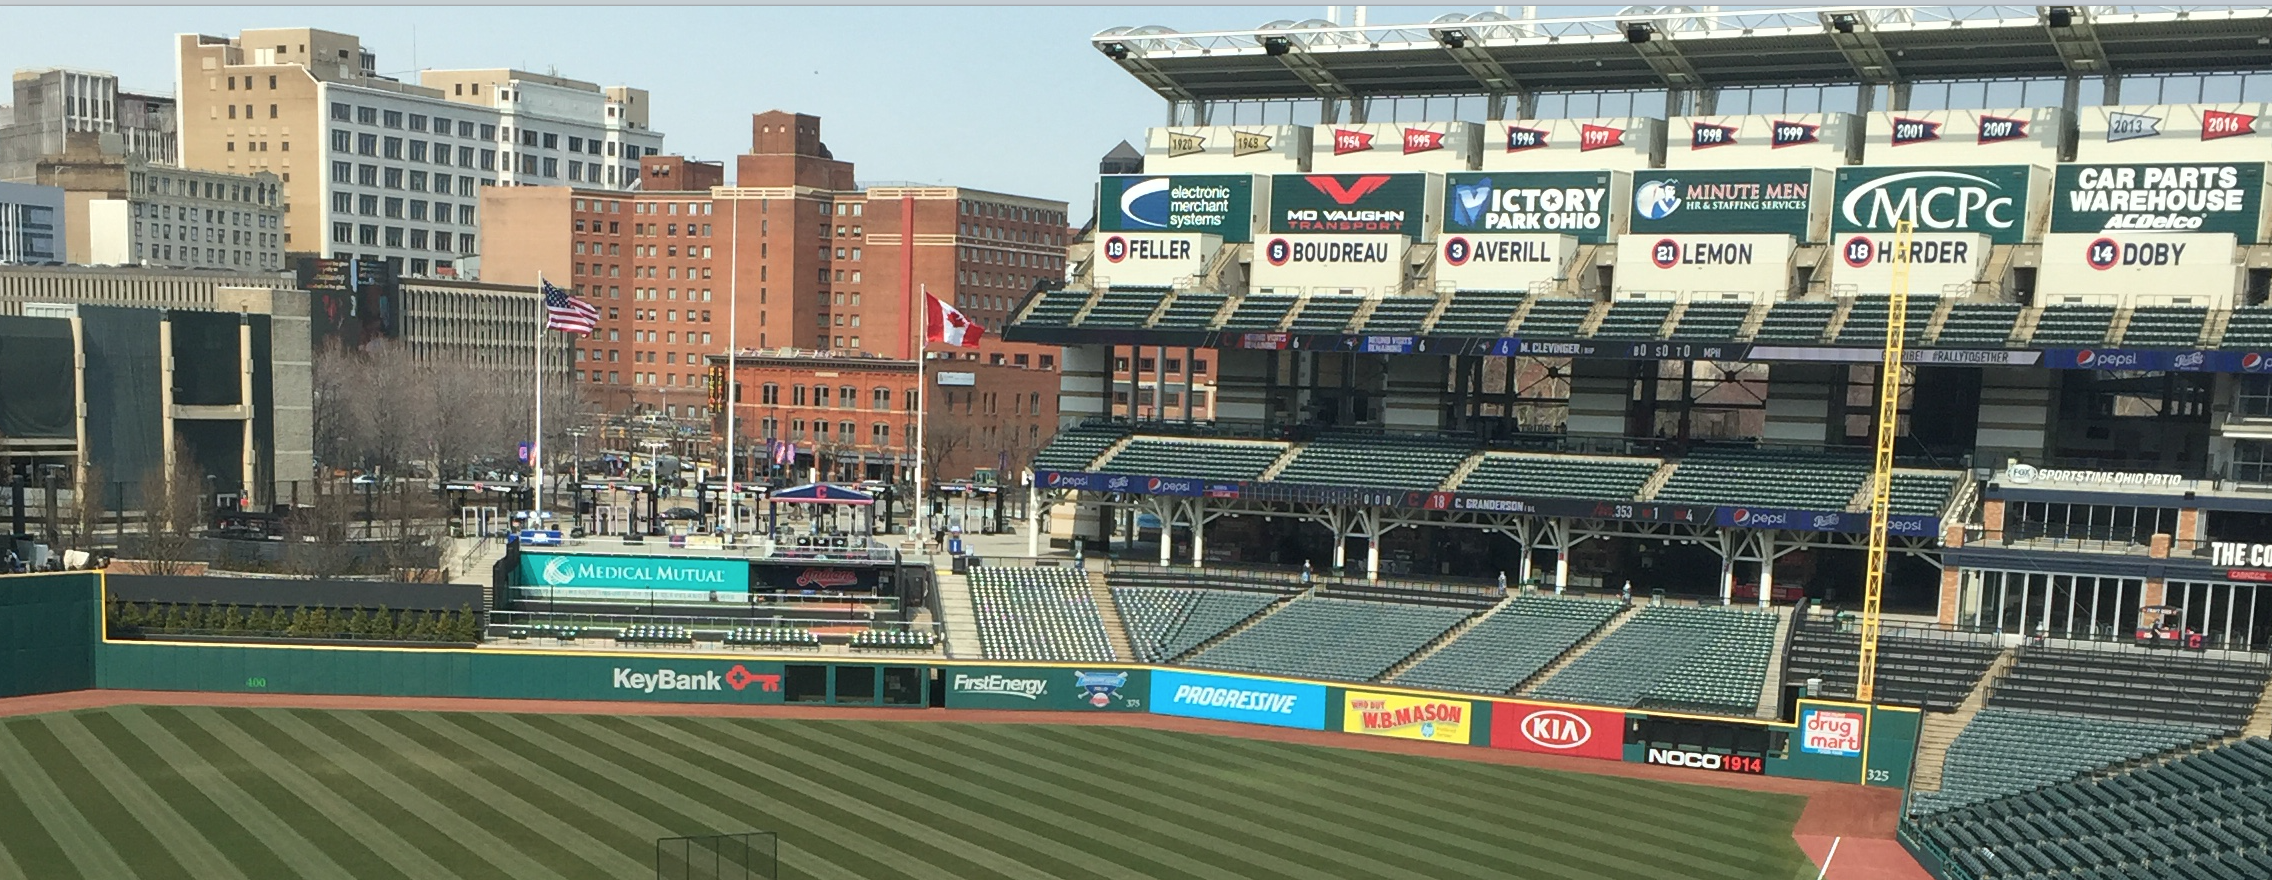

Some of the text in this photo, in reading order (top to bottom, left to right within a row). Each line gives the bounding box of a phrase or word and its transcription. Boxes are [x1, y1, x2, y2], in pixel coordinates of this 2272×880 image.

[1897, 124, 1924, 138] 2001
[1983, 122, 2012, 136] 2007
[2114, 120, 2142, 134] 2013
[2208, 117, 2238, 132] 2016
[1408, 134, 1430, 148] 1995
[1512, 132, 1535, 146] 1996
[1585, 131, 1609, 144] 1997
[1697, 128, 1722, 142] 1998
[1778, 127, 1803, 141] 1999
[1172, 138, 1193, 150] 1920
[1338, 135, 1360, 148] 1954
[2078, 166, 2237, 189] CAR PARTS
[1171, 185, 1230, 199] electronic
[1685, 183, 1809, 200] MINUTE MEN
[1170, 199, 1229, 212] merchant
[1458, 186, 1606, 223] VICTORY
[1686, 200, 1806, 210] HR & STAFFING SERVICES
[1867, 186, 2015, 229] MCPc
[2070, 189, 2244, 212] WAREHOUSE
[1322, 210, 1404, 220] VAUGHN
[1485, 212, 1601, 230] PARK OHIO
[2104, 213, 2203, 230] ACDelco
[1288, 220, 1403, 230] TRANSPORT
[1108, 240, 1190, 260] 19 FELLER
[1274, 242, 1388, 263] 5 BOUDREAU
[1452, 241, 1551, 262] 3 AVERILL
[1656, 244, 1752, 264] 21 LEMON
[1849, 241, 1968, 264] 18 HARDER
[2092, 243, 2186, 266] 14 DOBY
[1293, 336, 1300, 348] 6
[1419, 340, 1426, 352] 6
[1502, 341, 1508, 354] 6
[1532, 342, 1580, 354] CLEVINGER
[1704, 348, 1721, 358] MPH
[1902, 350, 1924, 362] RIBE!
[1932, 350, 2009, 362] #RALLYTOGETHER
[2098, 352, 2136, 366] pepsi
[1062, 476, 1088, 487] pepsi
[2012, 468, 2182, 486] FOX SPORTSTIME OHIO PATIO
[1162, 482, 1190, 493] pepsi
[1433, 495, 1444, 508] 18
[1466, 499, 1524, 512] GRANDERSON
[1612, 505, 1632, 519] .353
[1686, 509, 1693, 522] 4
[1752, 513, 1786, 526] pepsi
[2212, 542, 2247, 566] THE
[578, 564, 724, 582] MEDICAL MUTUAL
[246, 678, 266, 688] 400
[614, 668, 722, 693] KeyBank
[954, 674, 1048, 695] FirstEnergy
[1174, 684, 1298, 714] PROGRESSIVE
[1533, 718, 1579, 741] KIA
[1808, 710, 1851, 737] drug
[1810, 736, 1859, 750] mart
[1648, 748, 1761, 772] NOCO 1914
[1867, 769, 1889, 782] 325
